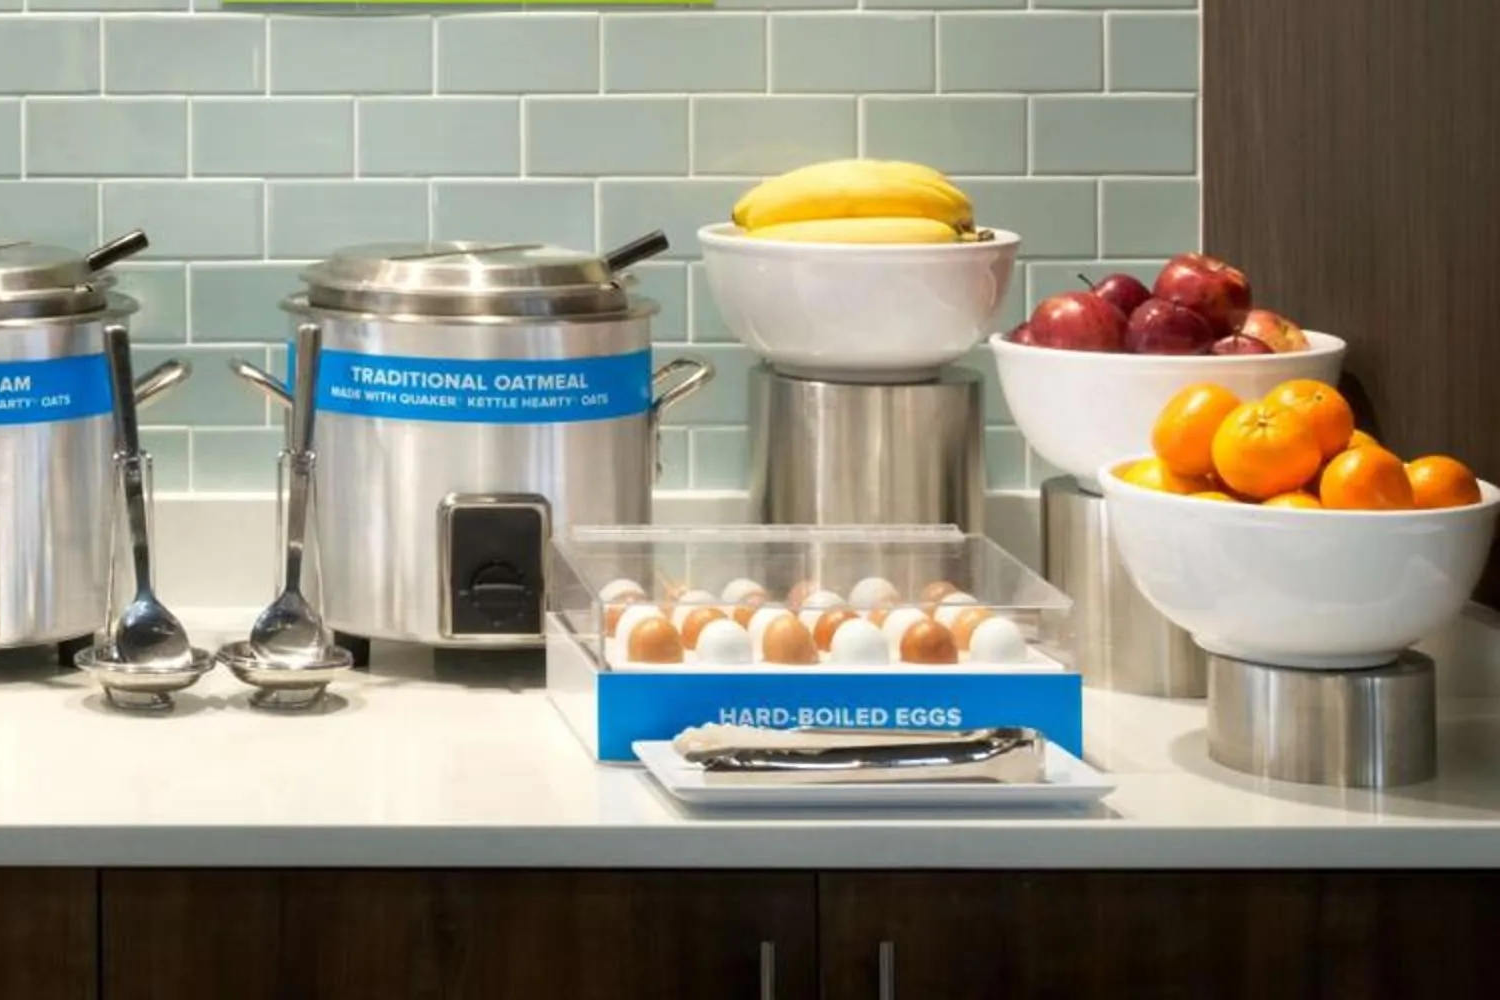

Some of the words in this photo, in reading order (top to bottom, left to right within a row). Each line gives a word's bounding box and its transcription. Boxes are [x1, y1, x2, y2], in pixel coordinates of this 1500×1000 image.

[351, 366, 488, 391] TRADITIONAL
[493, 372, 588, 391] OATMEAL
[41, 393, 71, 408] OATS
[364, 390, 397, 404] WITH
[719, 707, 889, 726] HARD-BOILED
[895, 707, 962, 726] EGGS
